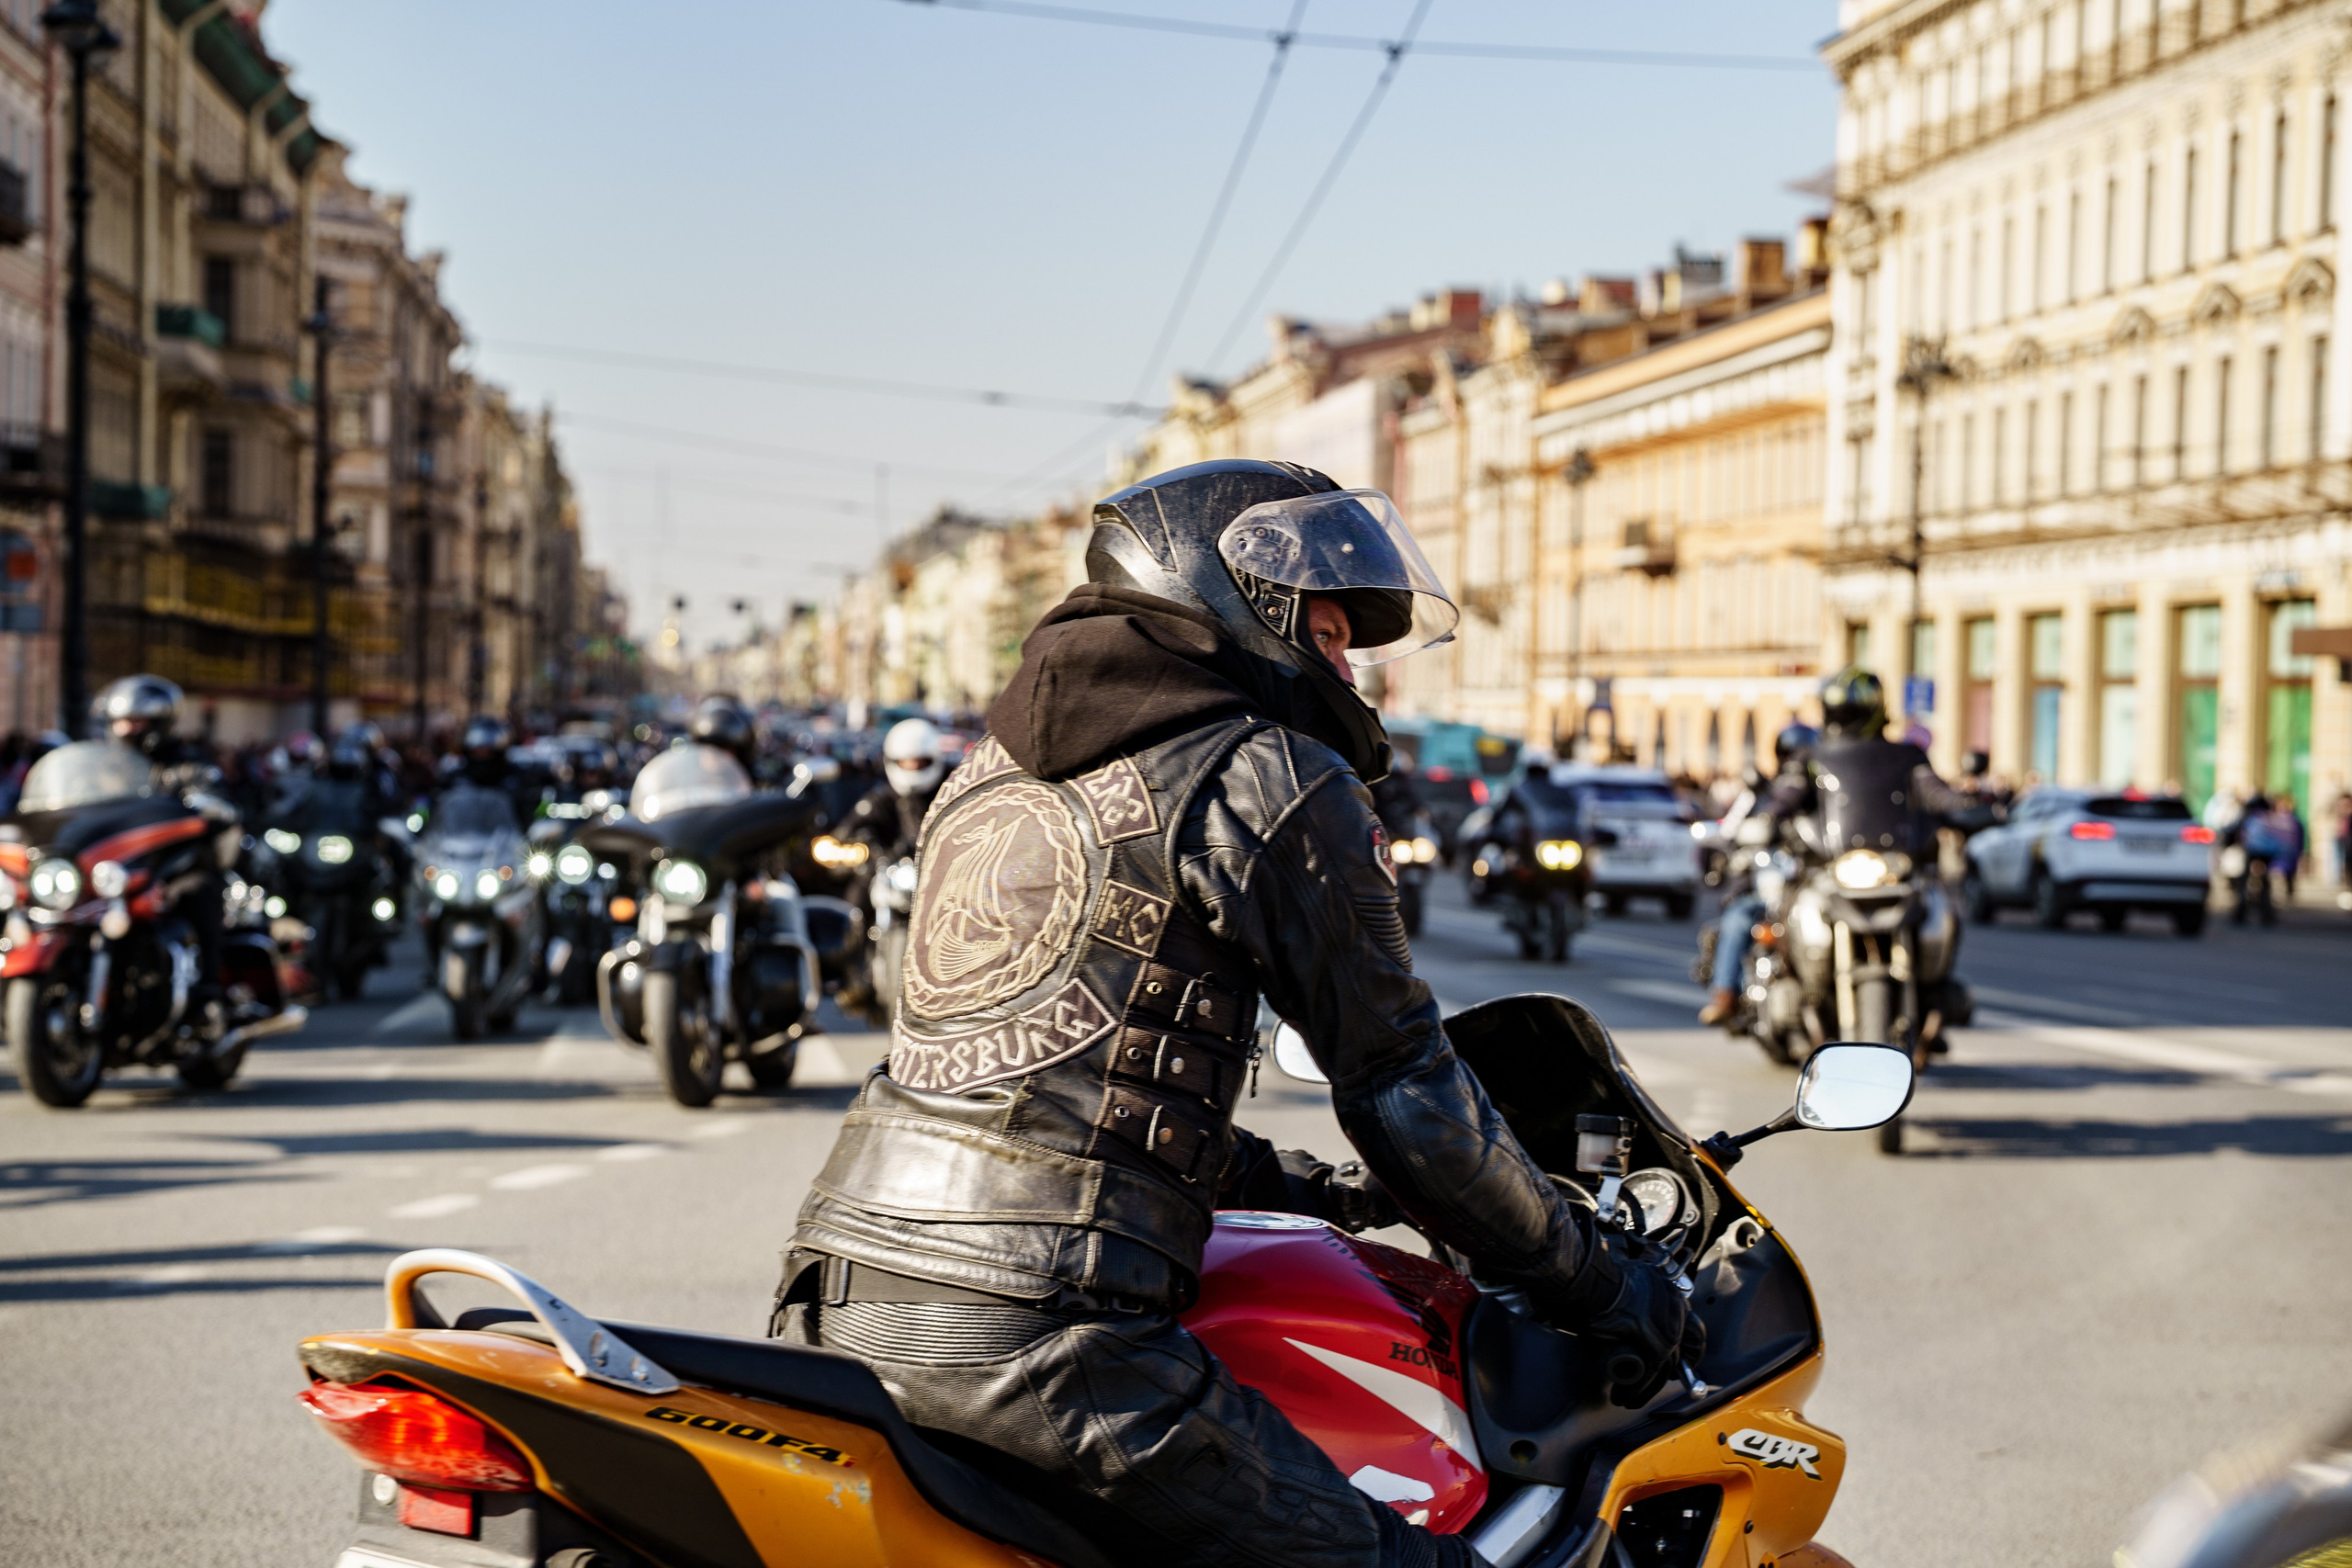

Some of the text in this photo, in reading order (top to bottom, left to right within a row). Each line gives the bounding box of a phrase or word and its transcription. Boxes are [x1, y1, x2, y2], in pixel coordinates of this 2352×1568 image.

[1096, 888, 1161, 945] MC
[1389, 1341, 1459, 1381] HONDA
[1727, 1428, 1822, 1480] CBR
